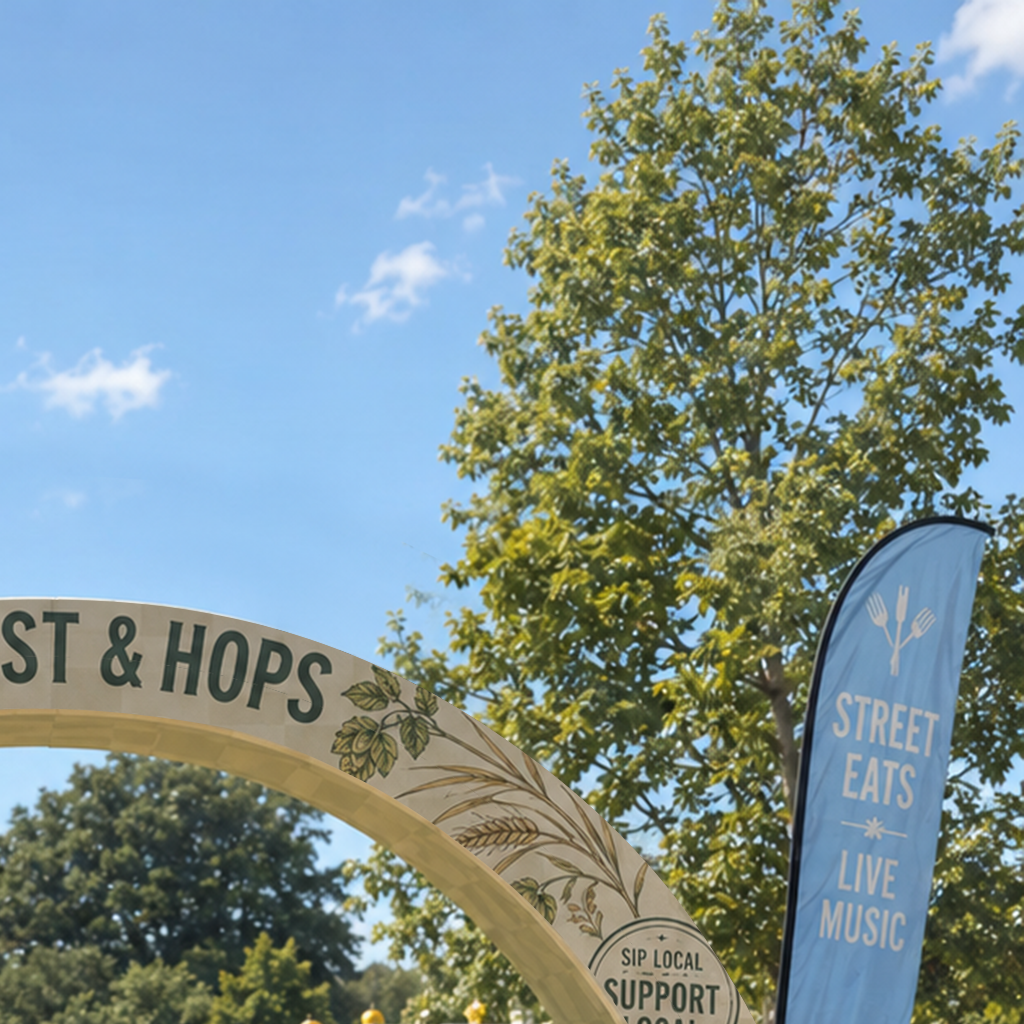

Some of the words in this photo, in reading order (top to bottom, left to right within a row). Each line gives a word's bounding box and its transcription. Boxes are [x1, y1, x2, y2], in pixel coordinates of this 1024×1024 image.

[99, 615, 143, 688] &
[159, 620, 333, 724] HOPS
[832, 691, 940, 758] STREET
[842, 752, 916, 810] EATS
[838, 849, 899, 900] LIVE
[819, 898, 907, 952] MUSIC
[621, 947, 647, 967] SIP
[653, 949, 703, 971] LOCAL
[604, 977, 721, 1015] SUPPORT
